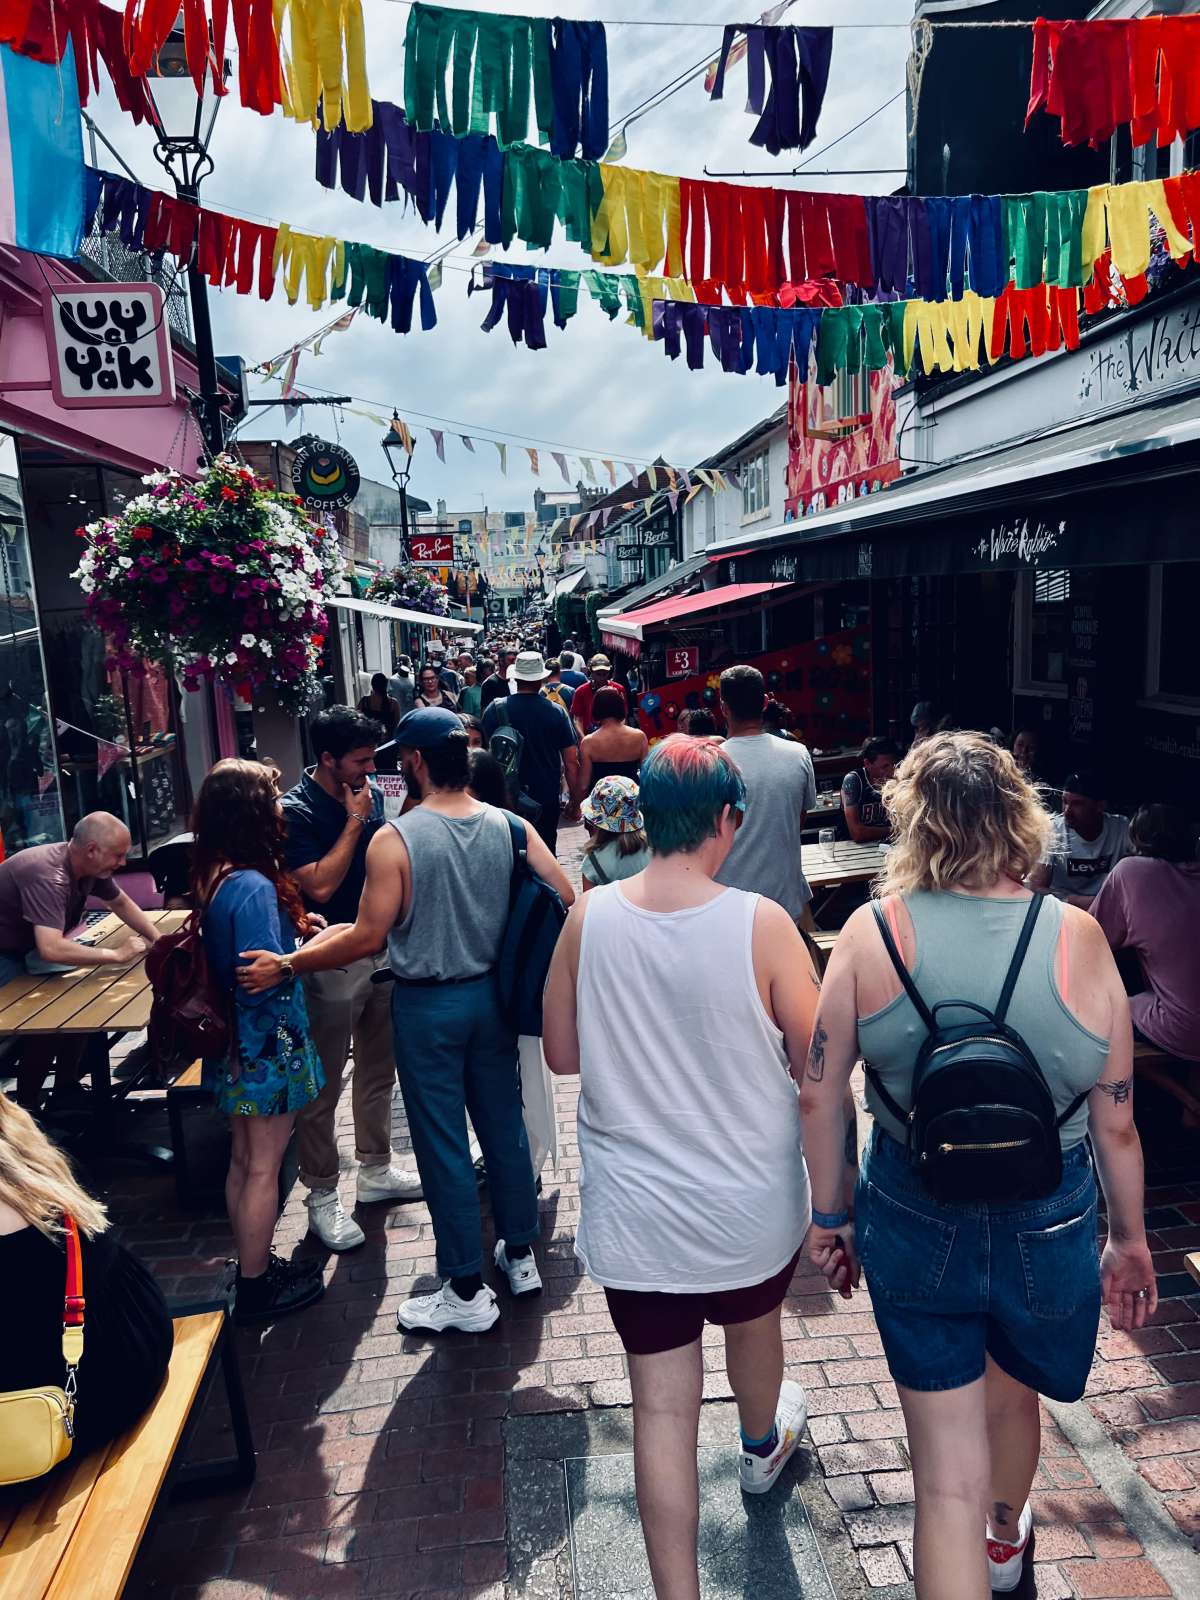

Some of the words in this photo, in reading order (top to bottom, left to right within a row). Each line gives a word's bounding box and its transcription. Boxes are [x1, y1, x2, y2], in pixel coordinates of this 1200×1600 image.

[65, 346, 153, 391] Yak
[292, 447, 310, 483] DOWN
[310, 441, 326, 453] TO
[329, 443, 359, 477] EARTH
[306, 492, 353, 510] COFFEE
[412, 538, 451, 559] Ray-Ban
[674, 651, 690, 669] £3
